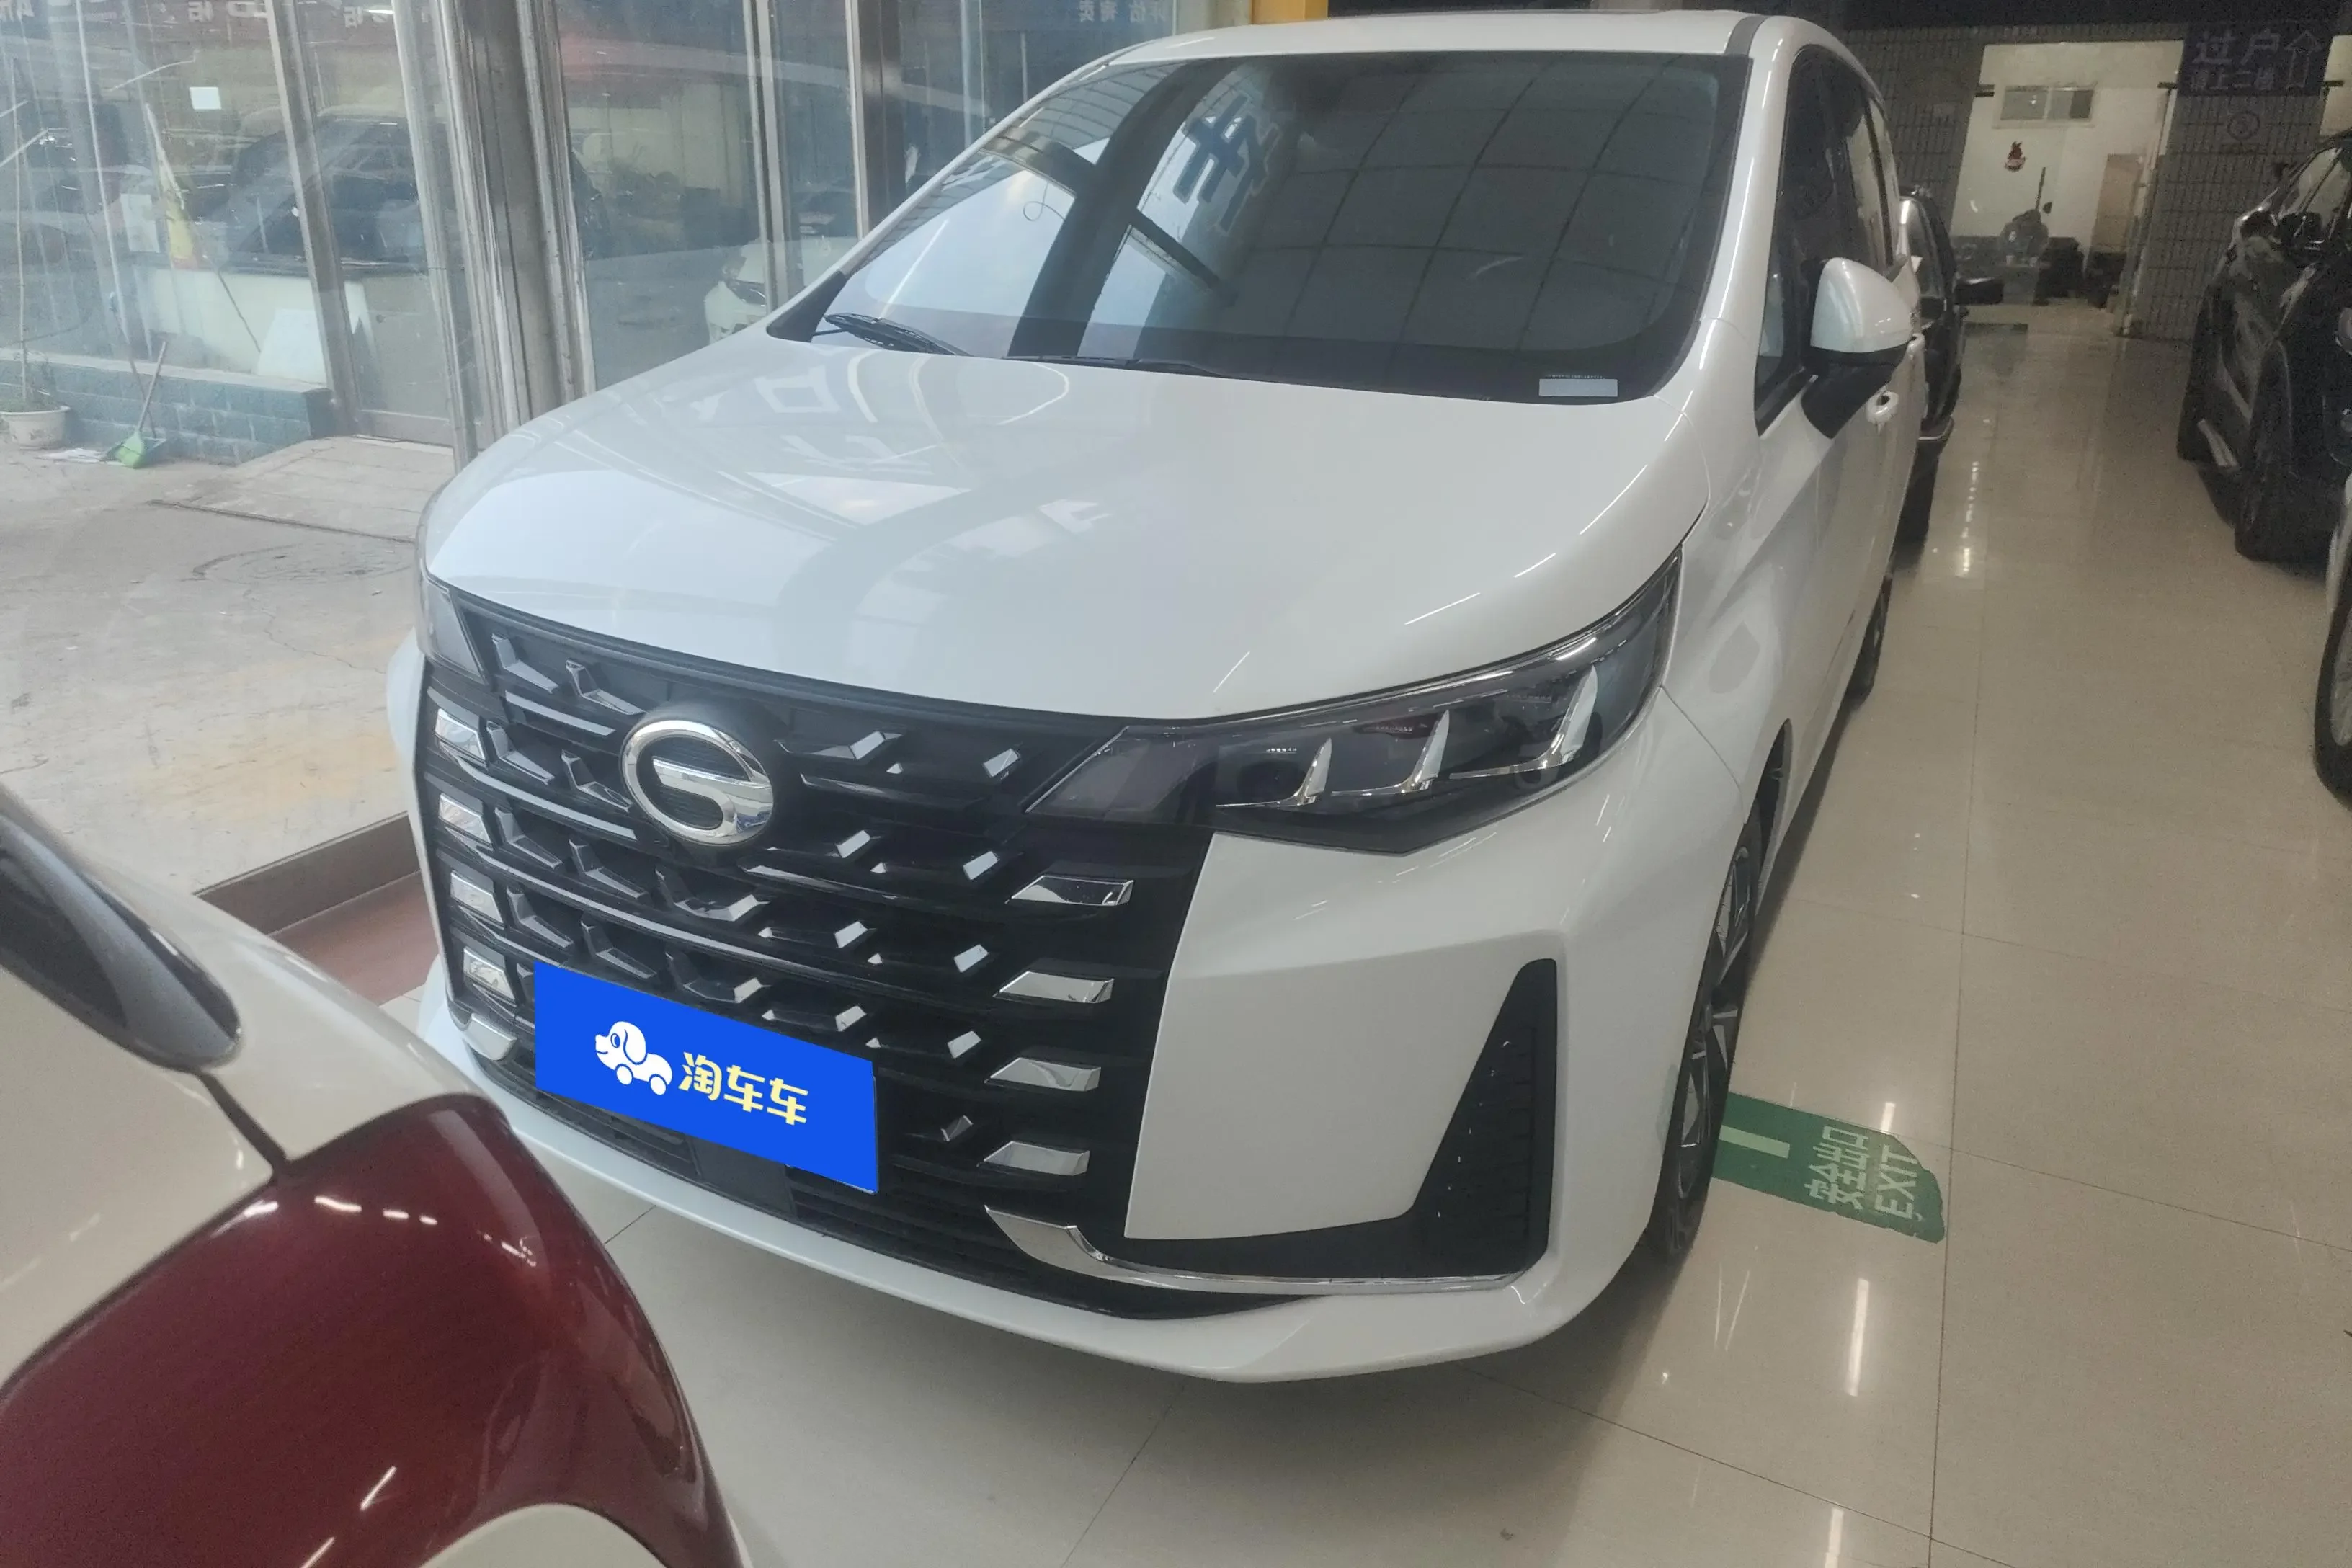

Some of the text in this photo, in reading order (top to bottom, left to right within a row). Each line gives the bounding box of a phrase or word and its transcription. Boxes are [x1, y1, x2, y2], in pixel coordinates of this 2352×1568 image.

[1804, 1126, 1870, 1210] 安全出口
[1875, 1144, 1918, 1219] EXIT
